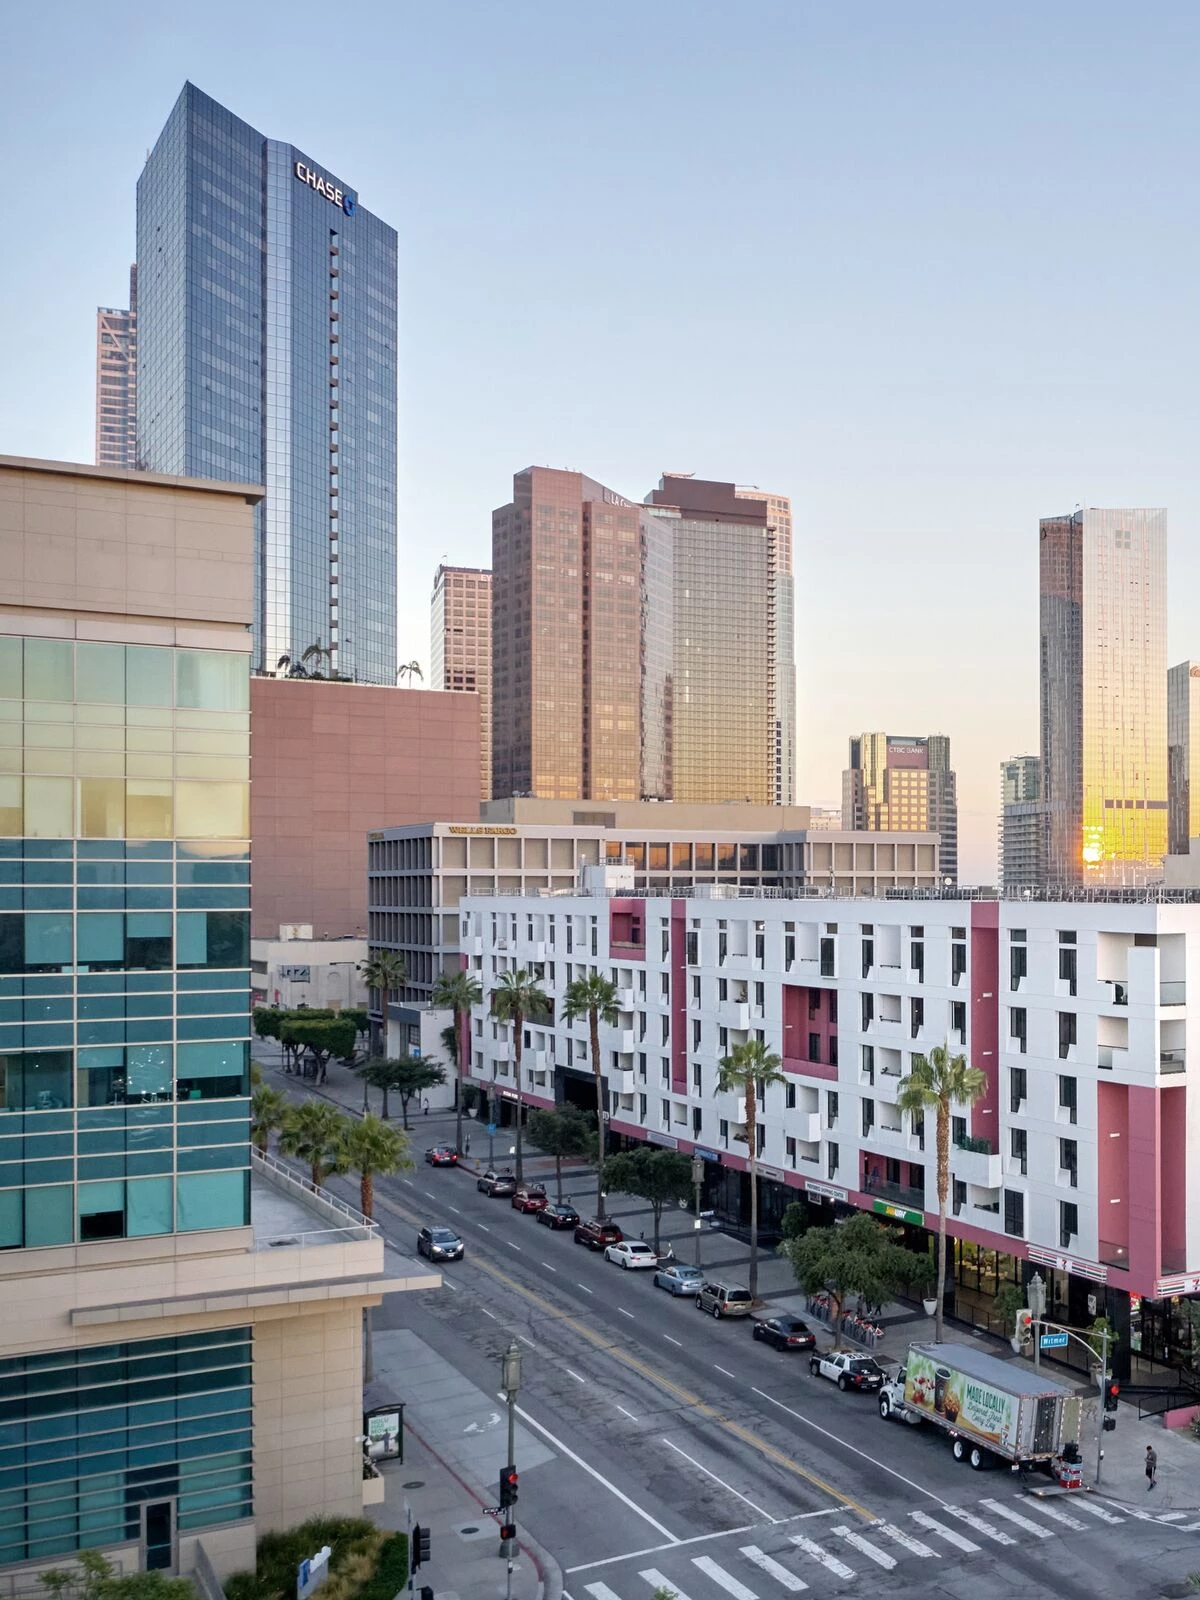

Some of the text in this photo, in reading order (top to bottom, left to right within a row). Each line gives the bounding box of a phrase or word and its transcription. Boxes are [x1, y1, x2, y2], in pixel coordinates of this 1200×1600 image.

[296, 161, 343, 208] CHASE
[449, 826, 517, 835] WELLS FARGO
[1043, 1337, 1065, 1345] Witmer
[967, 1384, 1006, 1415] MADE LOCALLY
